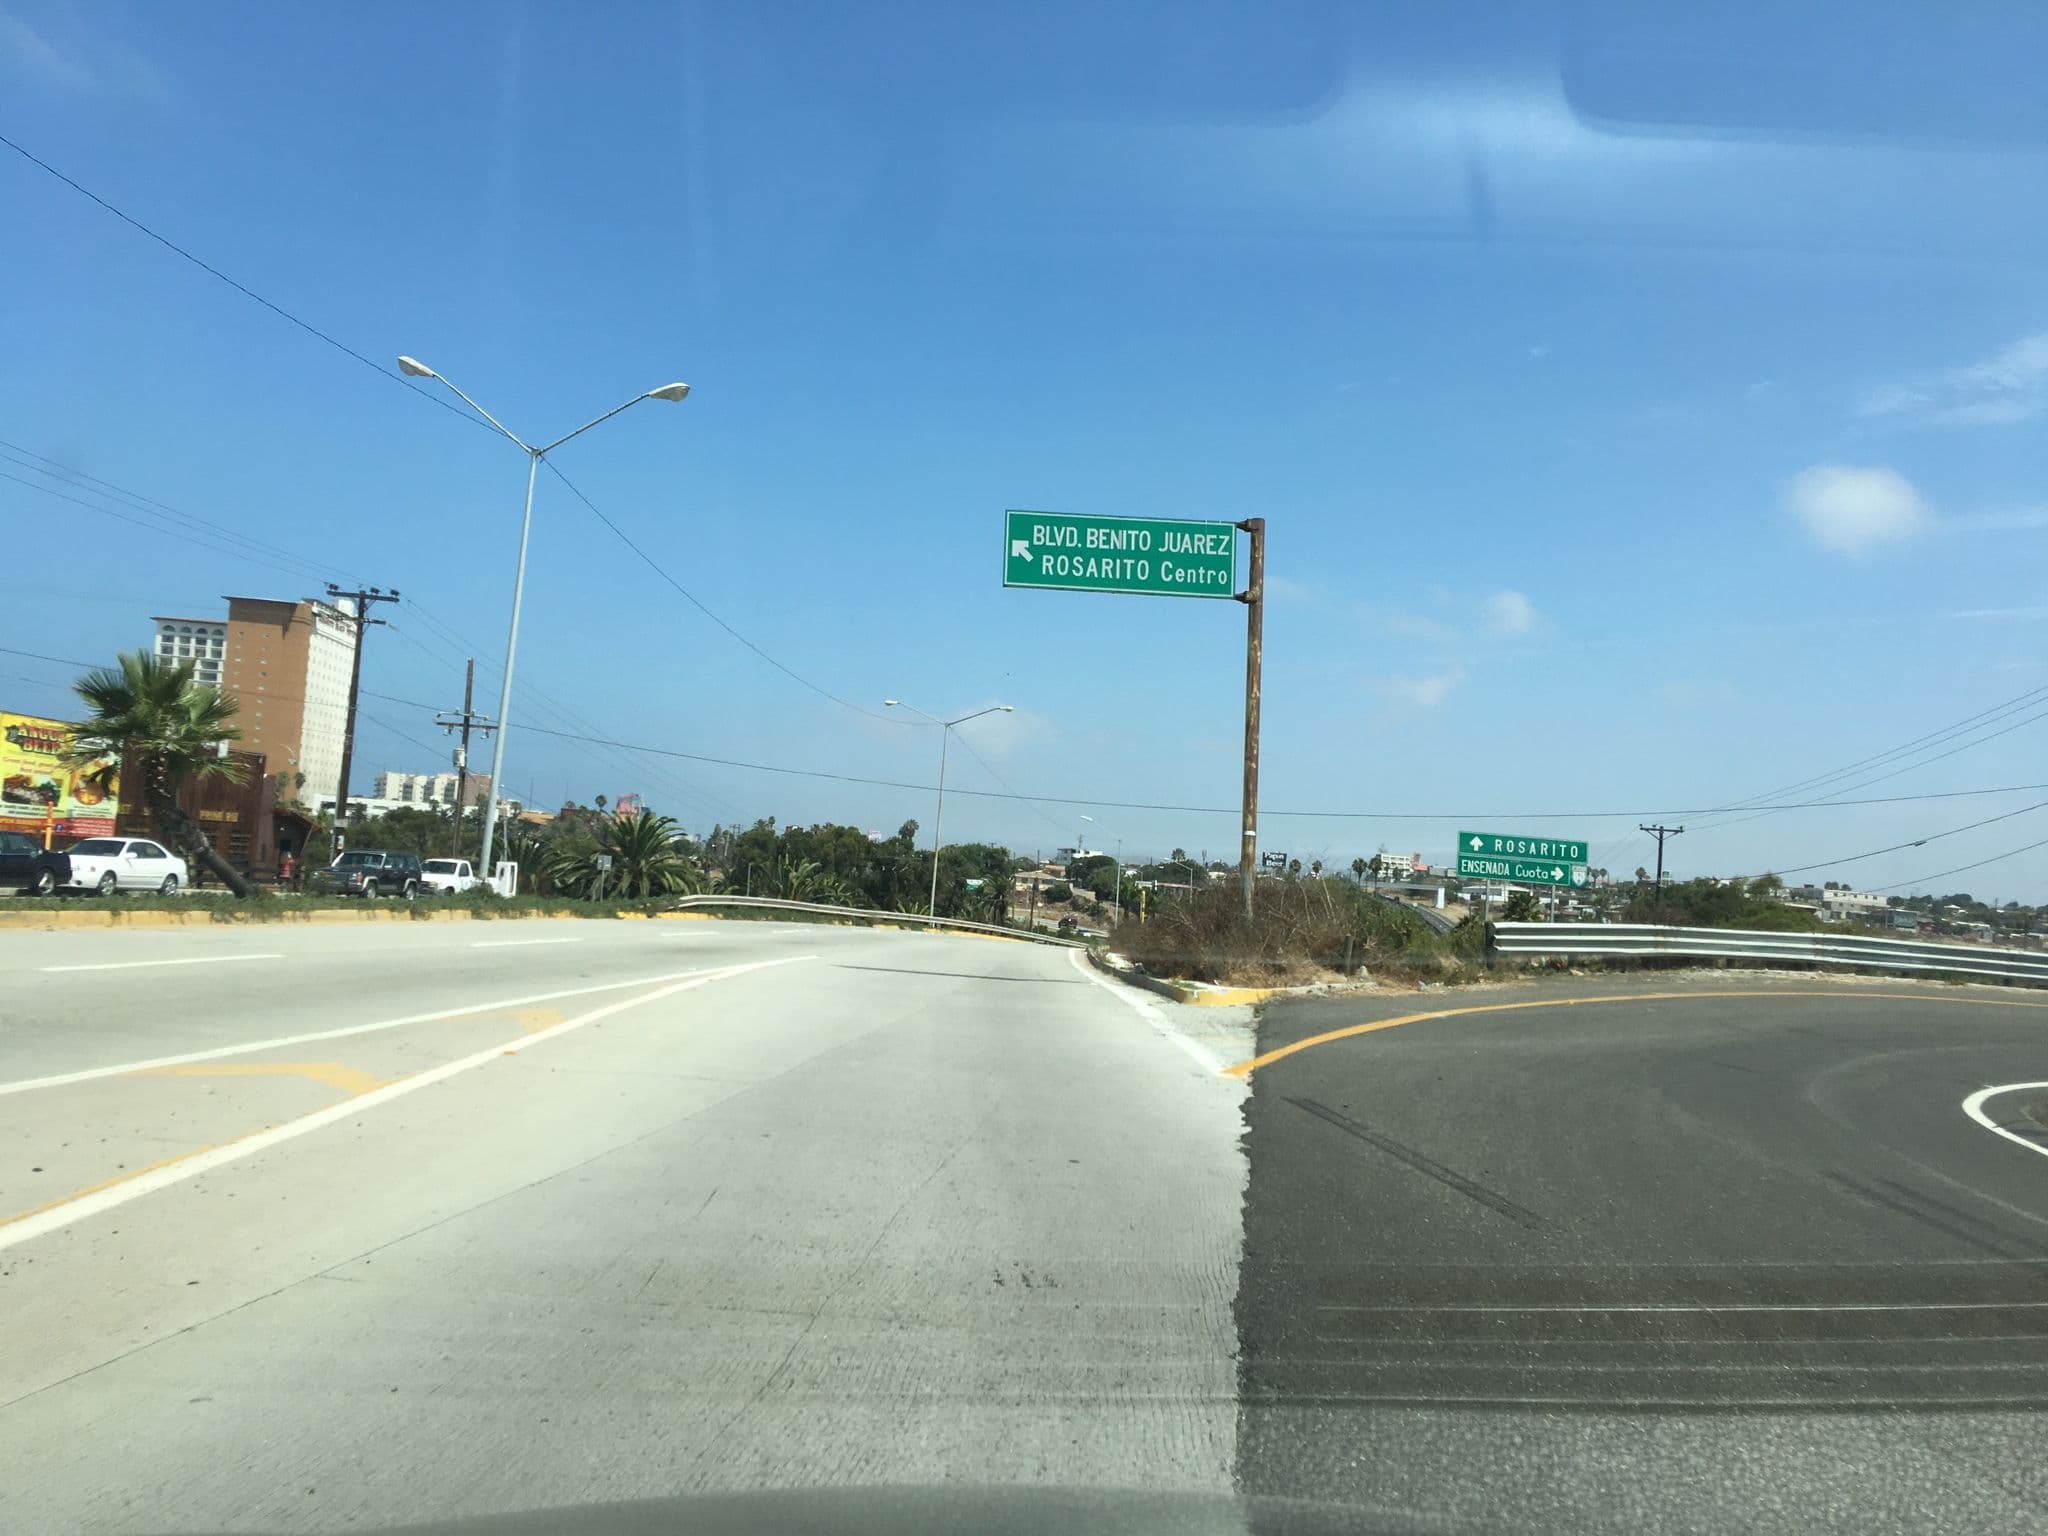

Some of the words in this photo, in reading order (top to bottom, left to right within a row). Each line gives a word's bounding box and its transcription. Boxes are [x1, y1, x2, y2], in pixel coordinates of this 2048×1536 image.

[1033, 525, 1082, 548] BLVD.
[1086, 528, 1151, 551] BENITO
[1158, 532, 1230, 556] JUAREZ
[1041, 555, 1150, 581] ROSARITO
[1160, 561, 1228, 585] Centro
[1494, 839, 1578, 858] ROSARITO
[1461, 859, 1510, 876] ENSENADA
[1515, 864, 1549, 880] Cuota
